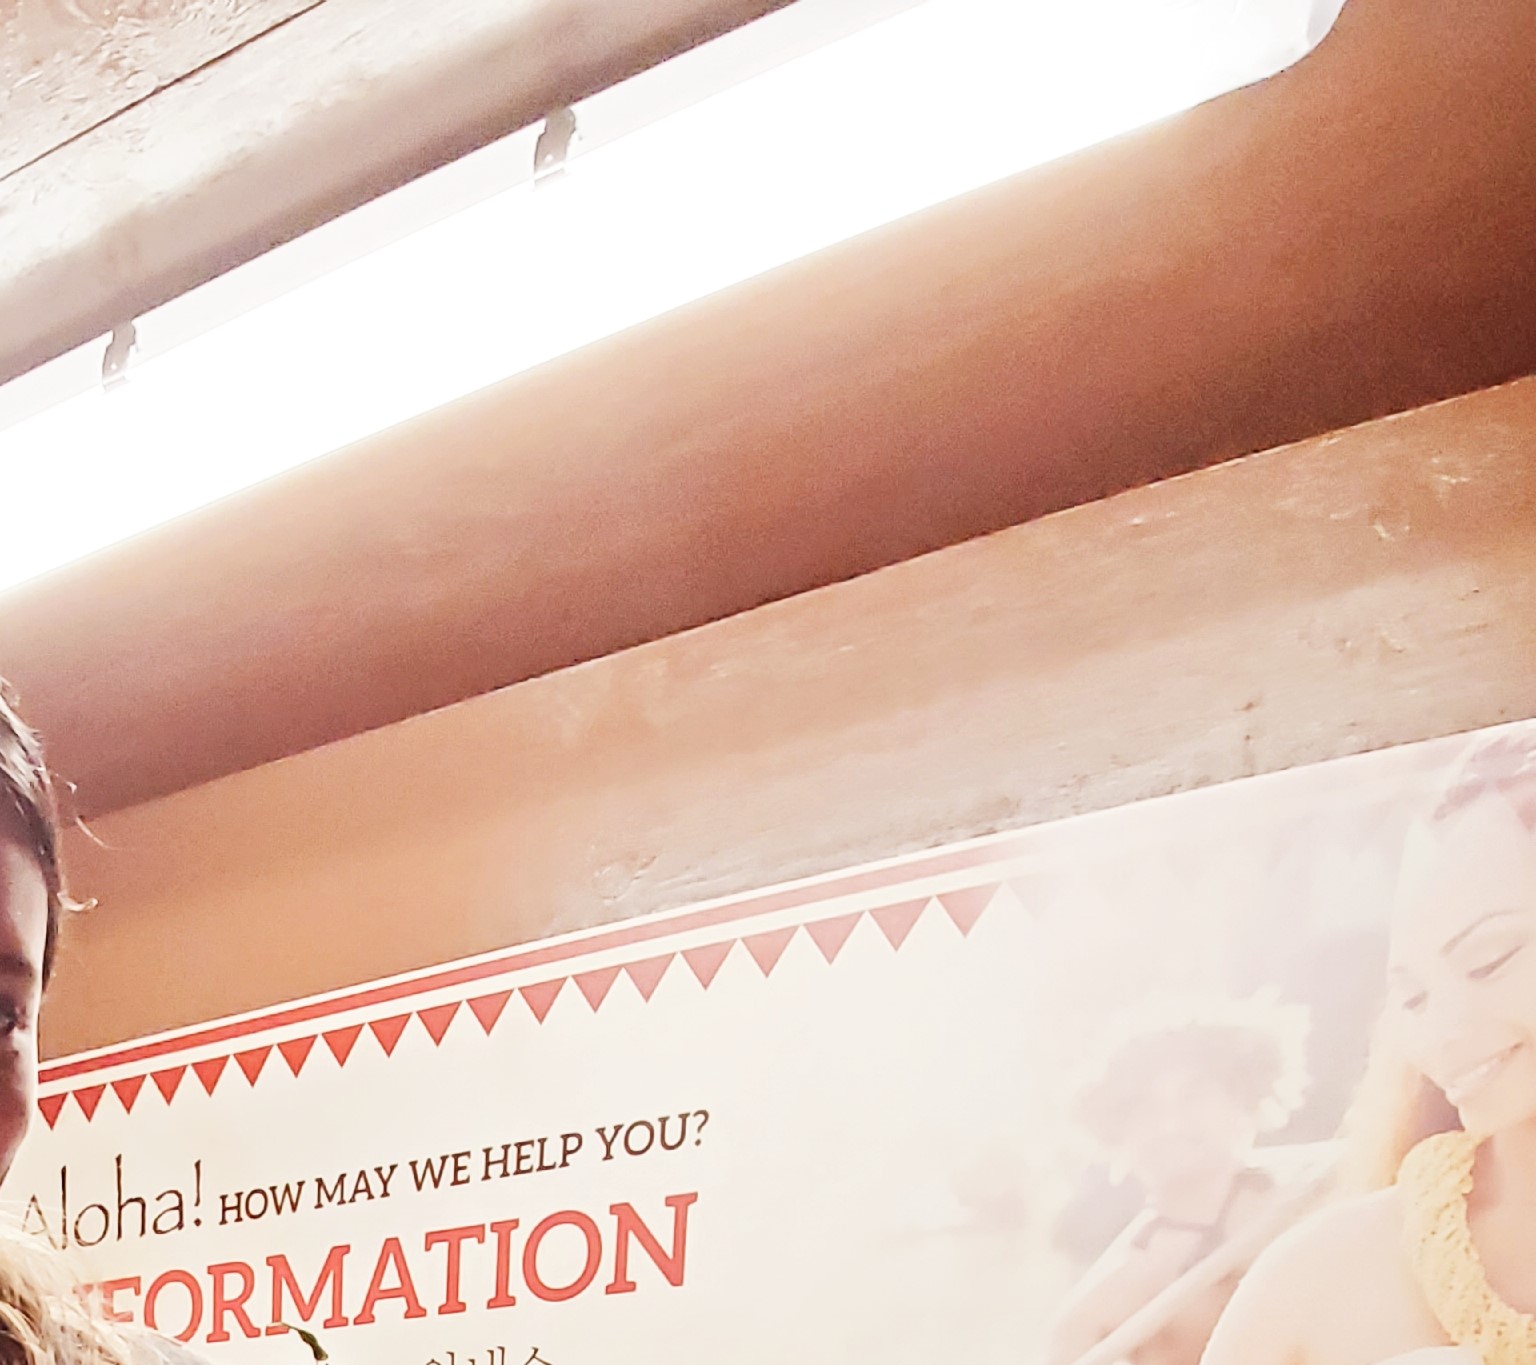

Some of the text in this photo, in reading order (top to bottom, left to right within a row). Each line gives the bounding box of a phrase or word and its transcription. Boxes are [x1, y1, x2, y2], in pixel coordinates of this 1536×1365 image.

[22, 1109, 710, 1249] Aloha! HOW MAY WE HELP YOU?
[72, 1191, 699, 1344] FORMATION
